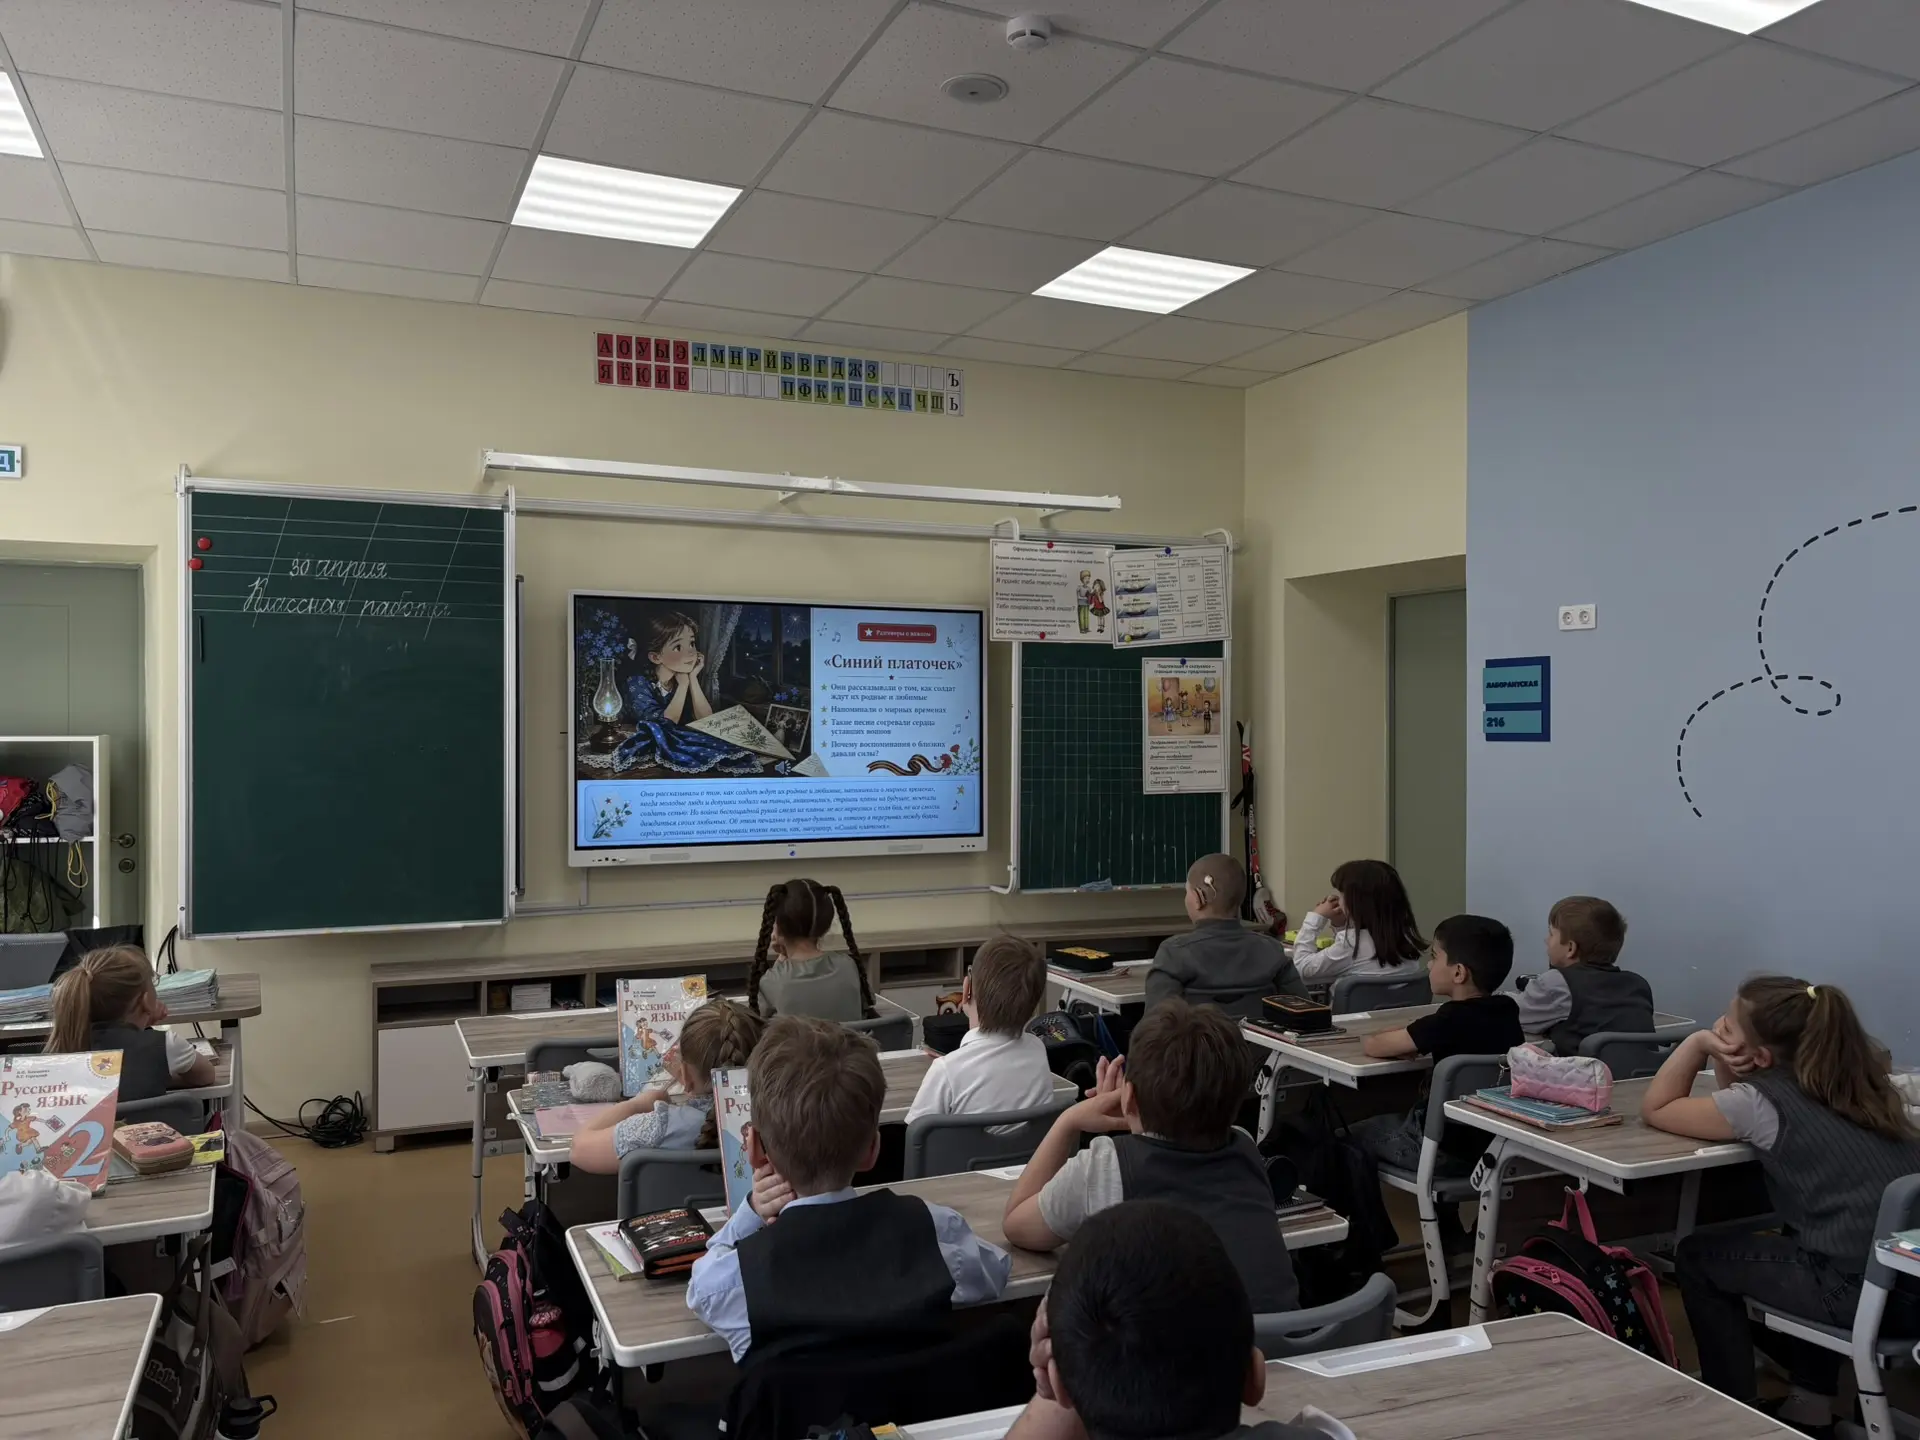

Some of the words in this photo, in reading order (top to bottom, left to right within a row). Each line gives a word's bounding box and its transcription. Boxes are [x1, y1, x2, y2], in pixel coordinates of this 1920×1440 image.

[600, 338, 612, 353] А
[620, 339, 629, 355] О
[637, 341, 648, 356] У
[656, 343, 670, 358] Ы
[676, 344, 686, 360] Э
[694, 347, 705, 362] Л
[712, 349, 723, 363] М
[730, 350, 742, 364] Н
[749, 352, 758, 366] Р
[766, 350, 776, 368] Й
[782, 356, 792, 370] Б
[800, 358, 810, 372] В
[816, 359, 826, 374] Г
[832, 361, 843, 380] Д
[849, 363, 862, 378] Ж
[867, 364, 876, 379] З
[948, 373, 959, 386] Ъ
[600, 364, 612, 379] Я
[620, 362, 630, 380] Ё
[636, 367, 650, 382] Ю
[657, 369, 668, 384] И
[676, 371, 686, 386] Е
[783, 382, 794, 396] П
[799, 383, 811, 398] Ф
[816, 384, 826, 399] К
[834, 386, 843, 400] Т
[868, 389, 876, 404] С
[884, 391, 895, 405] Х
[900, 392, 912, 410] Ц
[918, 394, 926, 408] Ч
[949, 397, 958, 411] Ь
[290, 558, 310, 577] 30
[243, 576, 345, 614] Классная
[824, 654, 882, 669] «Синий
[888, 660, 962, 671] платочек»
[1486, 680, 1538, 688] ЛАБОРАНТСКАЯ
[830, 694, 848, 702] ждут
[1486, 716, 1506, 728] 216
[831, 741, 858, 749] Почему
[918, 740, 946, 748] близких
[831, 750, 856, 758] давали
[624, 1000, 671, 1014] Русский
[0, 1081, 68, 1100] Русский
[63, 1120, 106, 1178] 2
